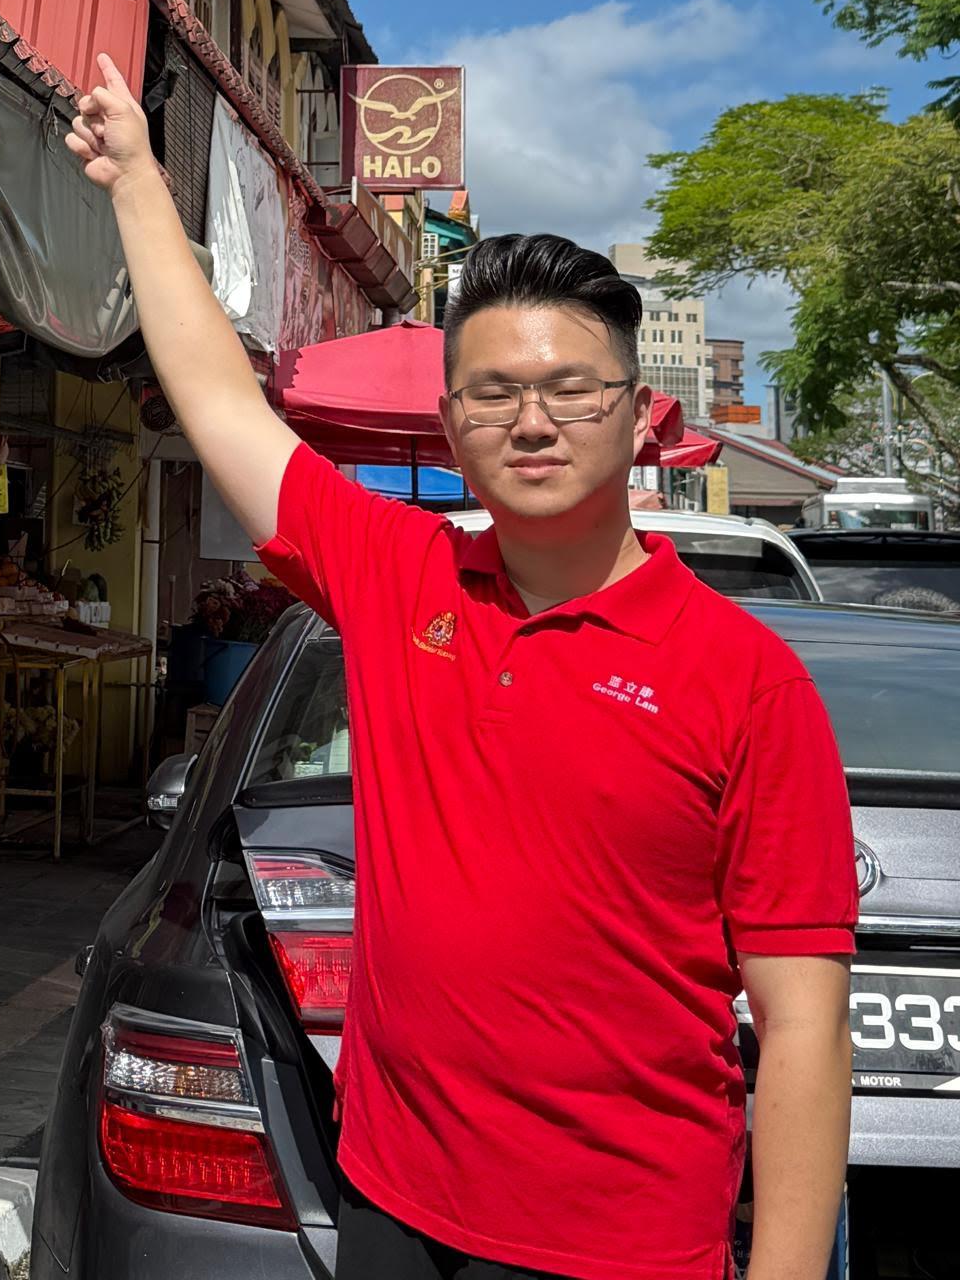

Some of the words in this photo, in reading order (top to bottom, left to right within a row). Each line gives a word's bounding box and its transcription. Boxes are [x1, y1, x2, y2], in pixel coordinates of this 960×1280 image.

[362, 155, 442, 179] HAI-O
[592, 682, 632, 703] George
[634, 696, 659, 714] Lam
[860, 1075, 902, 1087] MOTOR
